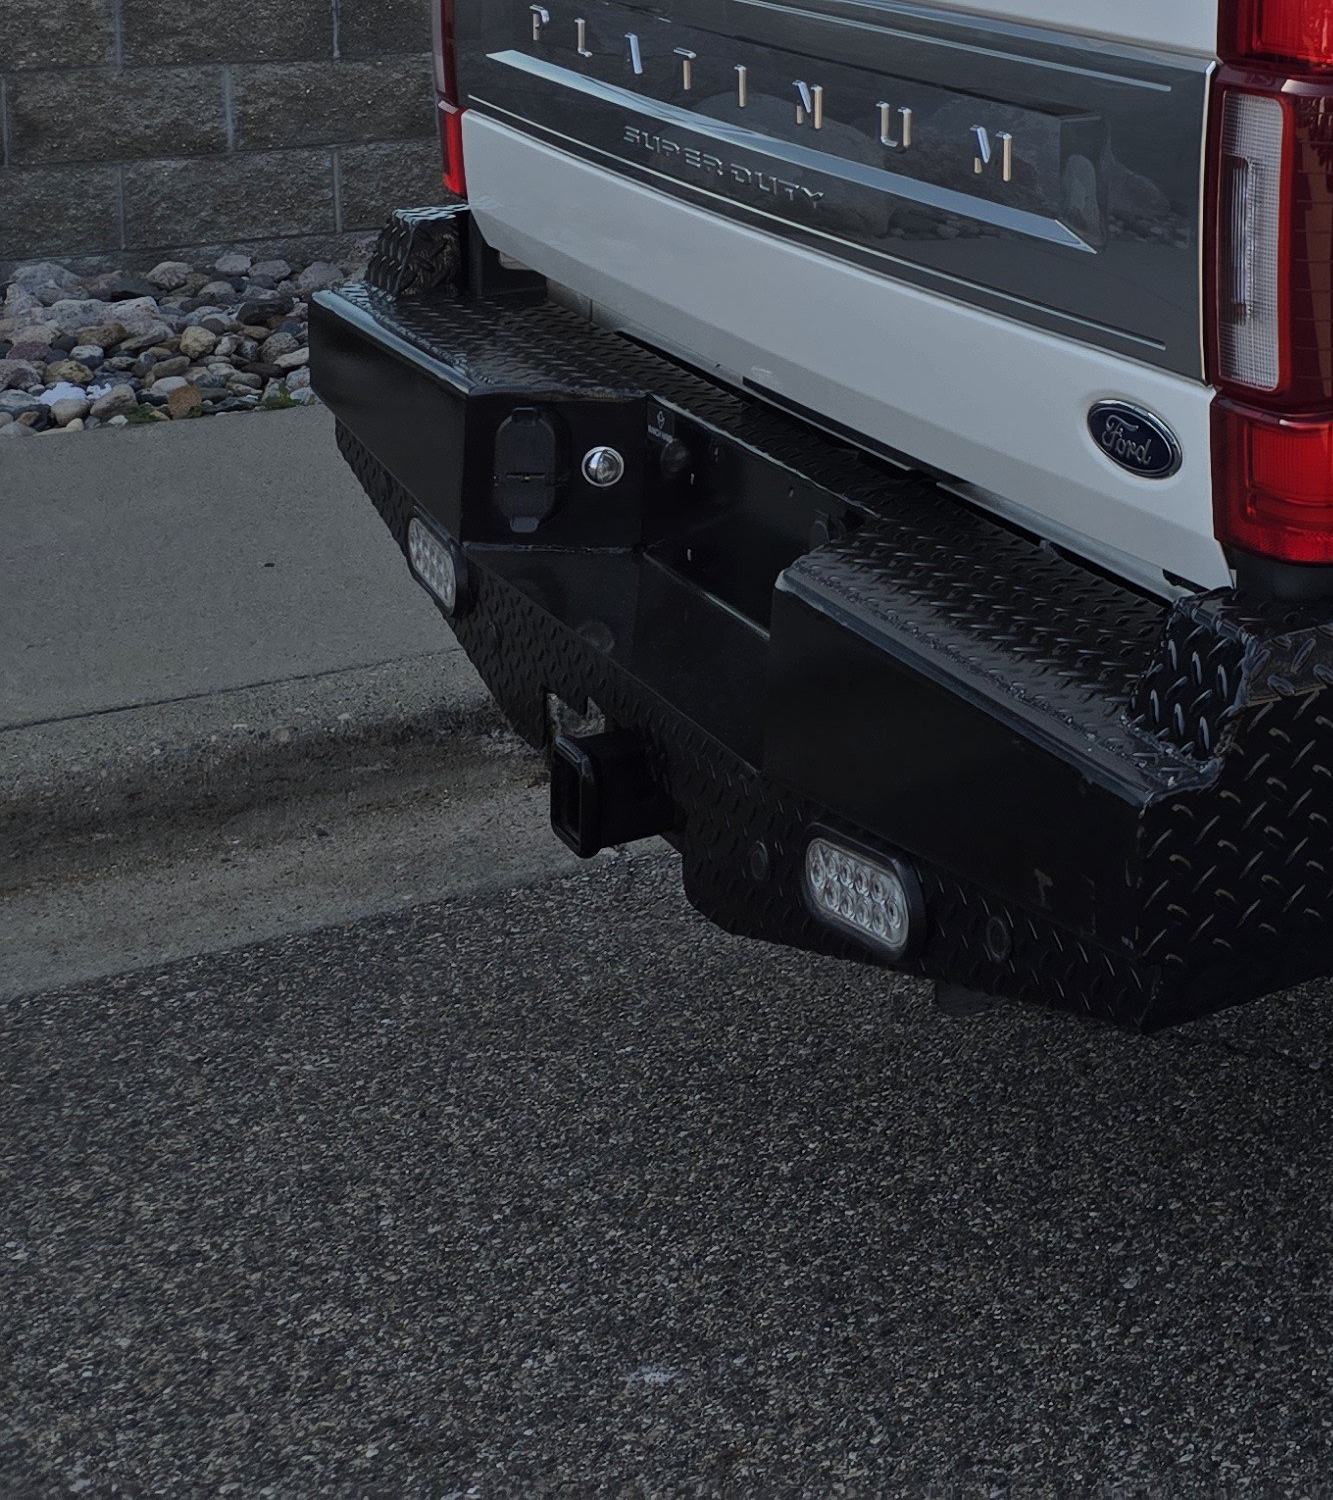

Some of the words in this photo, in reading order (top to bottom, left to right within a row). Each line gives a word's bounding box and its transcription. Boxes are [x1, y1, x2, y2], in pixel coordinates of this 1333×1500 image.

[529, 4, 1012, 182] PLATINUM
[623, 125, 723, 176] SUPER
[730, 163, 824, 209] DUTY
[1101, 414, 1152, 466] Ford
